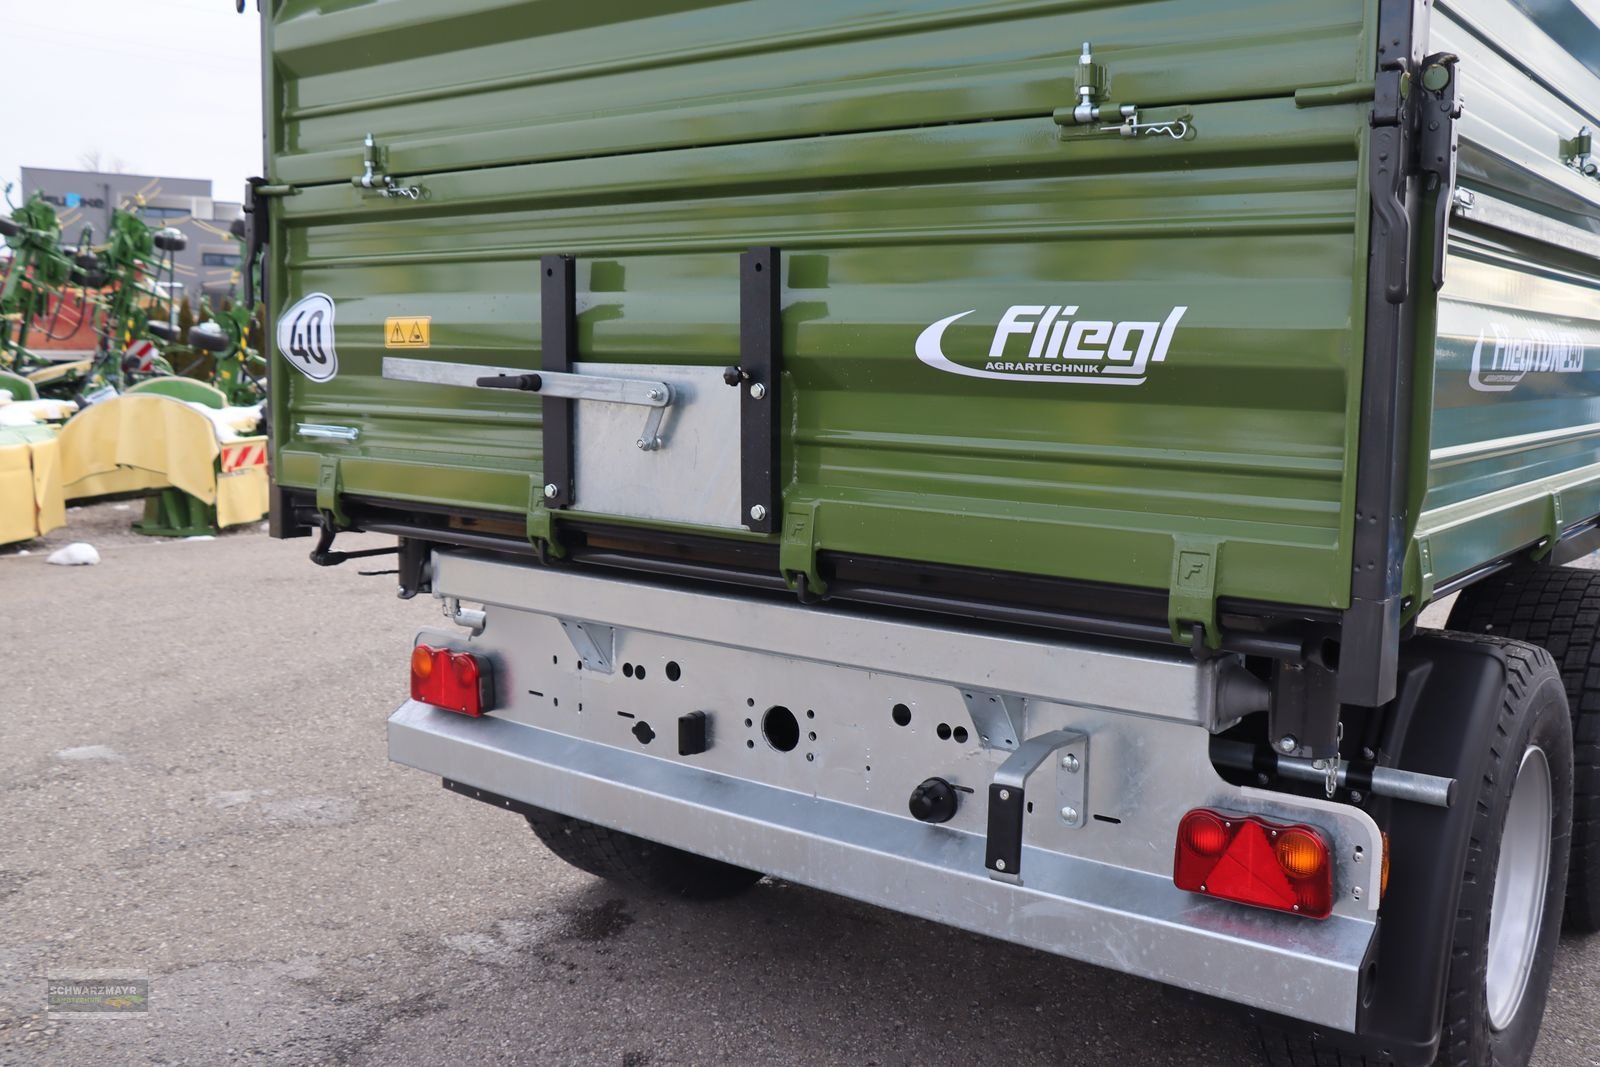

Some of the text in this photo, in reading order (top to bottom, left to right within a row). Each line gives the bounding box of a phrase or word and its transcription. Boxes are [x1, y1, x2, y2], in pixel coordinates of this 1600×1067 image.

[290, 310, 327, 364] 40
[988, 305, 1188, 375] Fliegl
[985, 361, 1100, 374] AGRARTECHNIK
